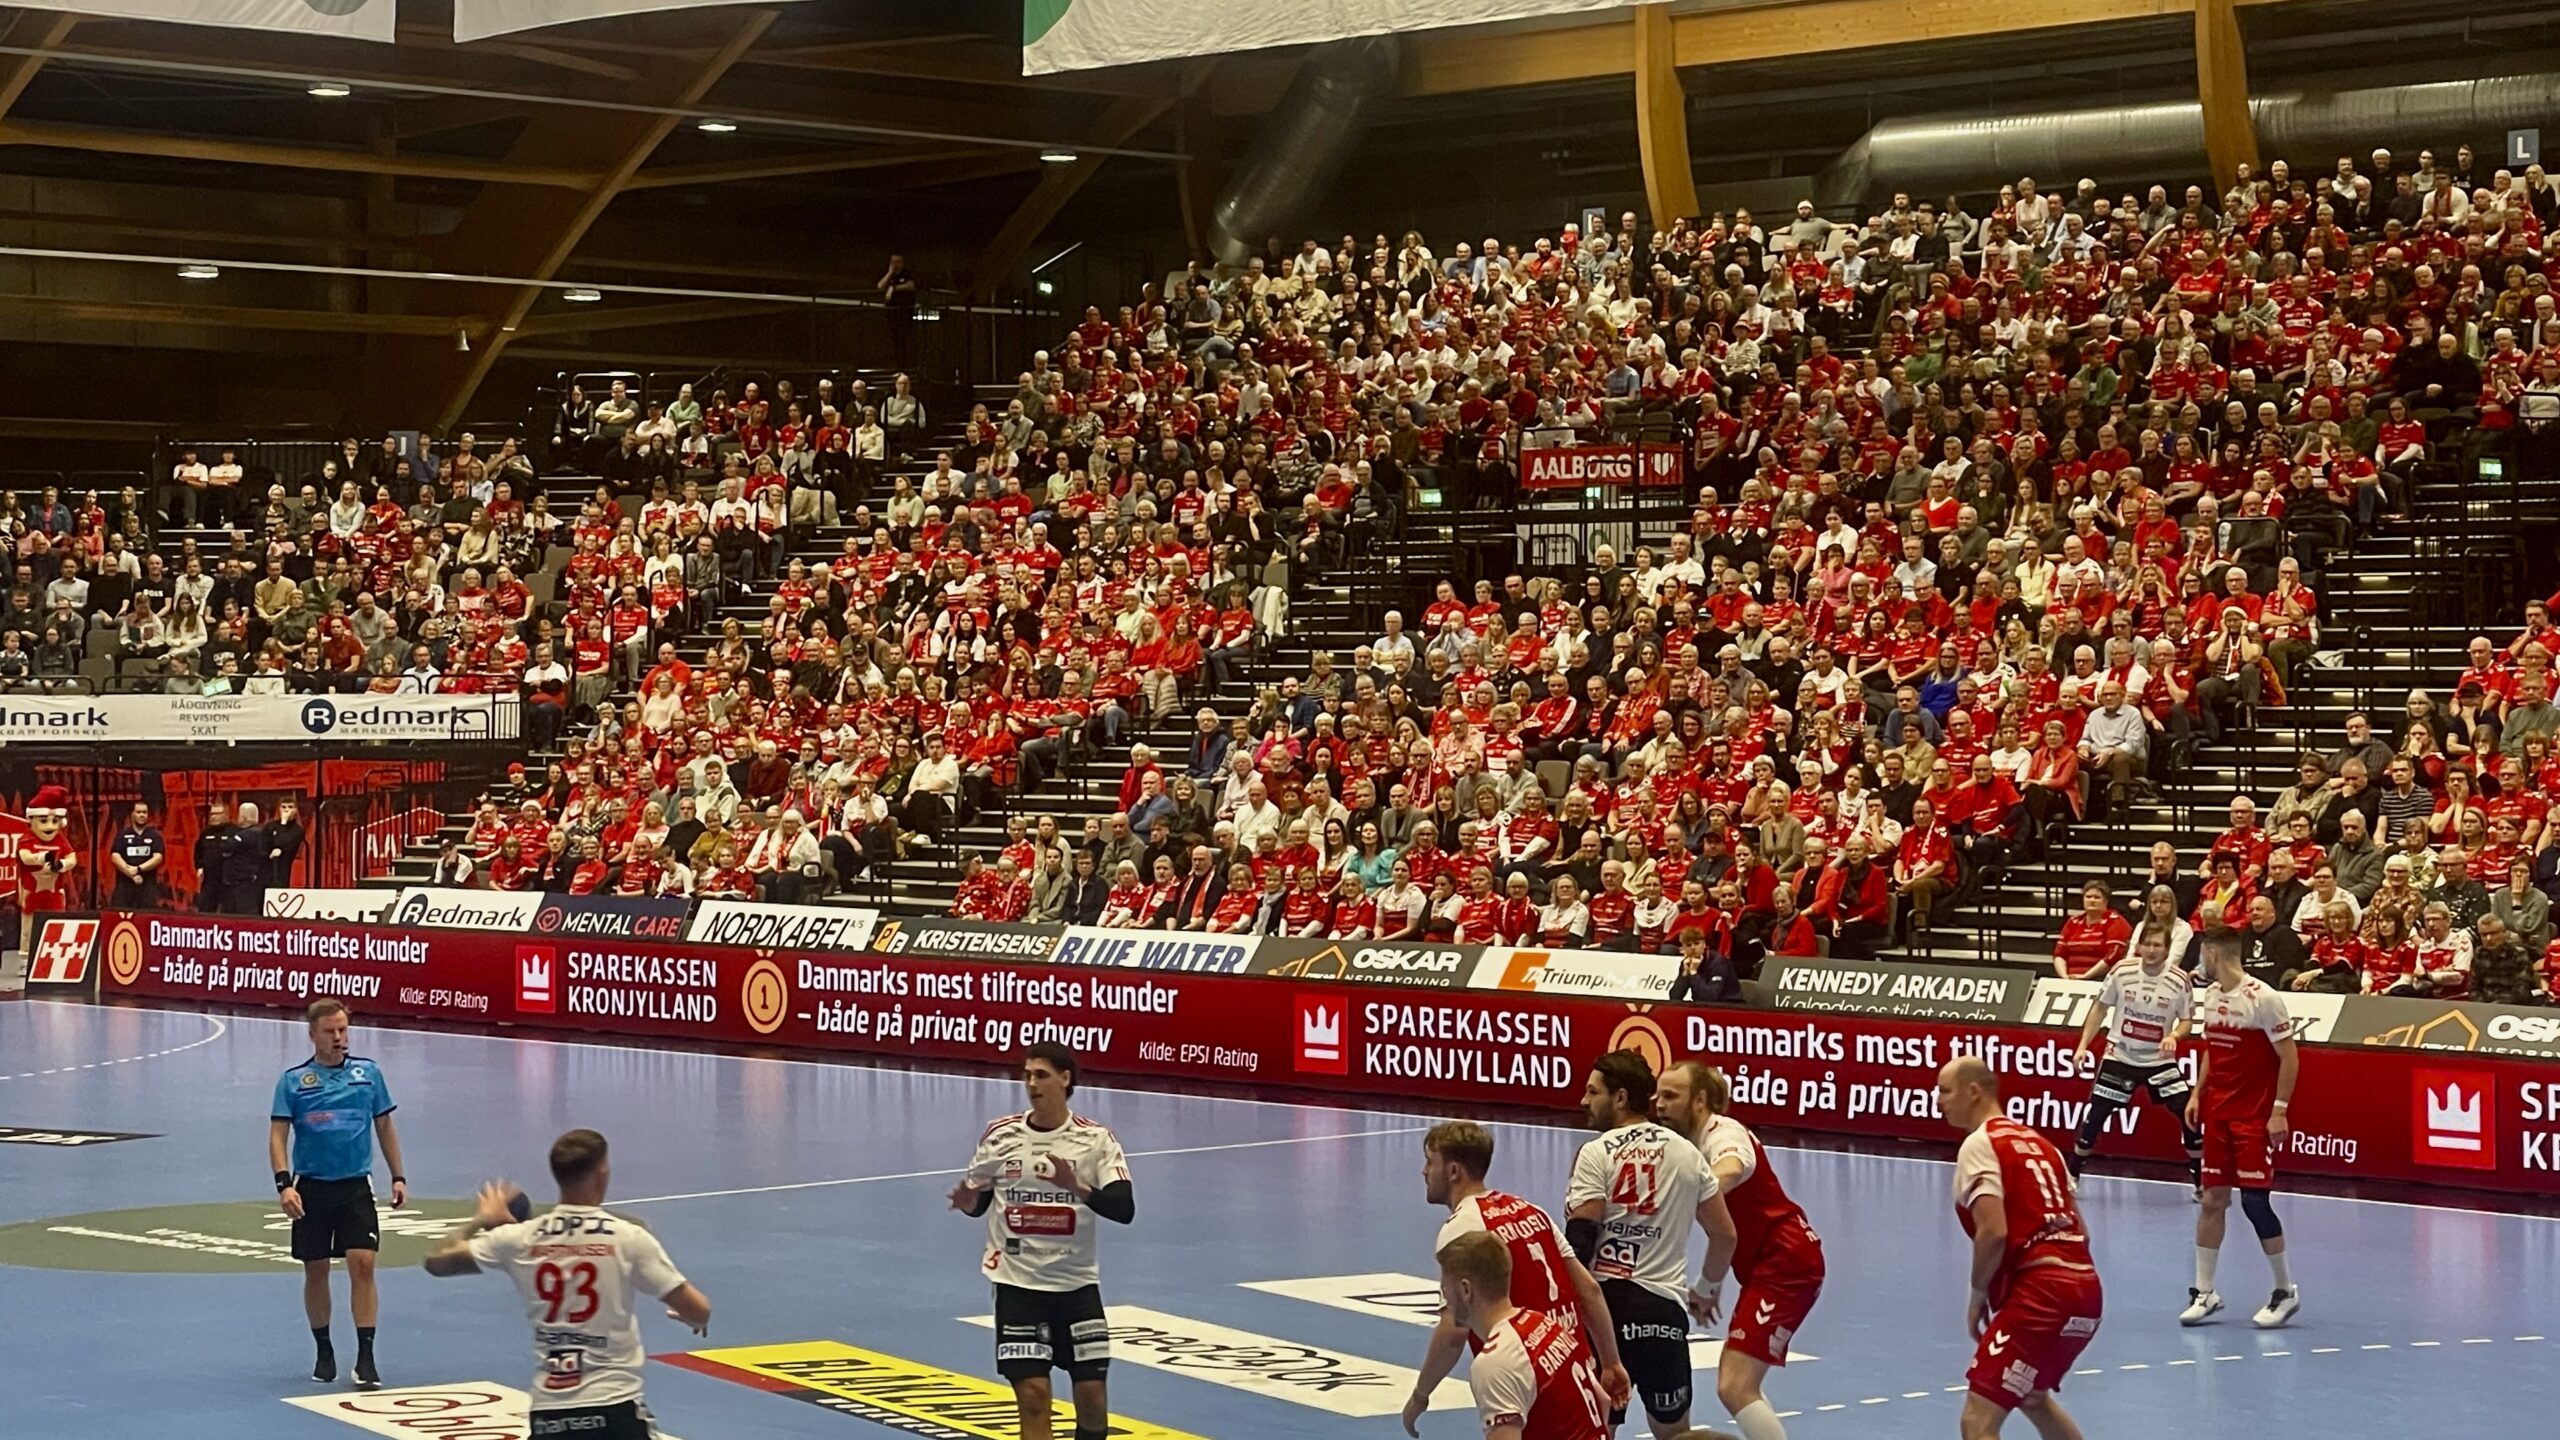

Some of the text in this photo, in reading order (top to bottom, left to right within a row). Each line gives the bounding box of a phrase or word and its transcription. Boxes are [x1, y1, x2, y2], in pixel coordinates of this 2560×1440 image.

[2517, 136, 2531, 159] L
[397, 436, 407, 457] J
[1530, 453, 1632, 481] AALBORG
[171, 699, 241, 710] RÅDGIVNING
[179, 713, 230, 722] REVISION
[303, 701, 471, 730] Redmark
[191, 726, 217, 736] SKAT
[401, 896, 525, 927] Redmark
[561, 911, 682, 937] MENTAL CARE
[150, 920, 429, 964] Danmarks mest tilfredse kunder
[701, 911, 854, 949] NORDKABEL
[913, 929, 1050, 956] KRISTENSENS
[40, 942, 89, 959] HTH
[1139, 941, 1247, 974] WATER
[1352, 948, 1462, 973] OSKAR
[164, 954, 203, 984] både
[208, 958, 228, 991] på
[233, 963, 283, 992] privat
[288, 970, 309, 998] og
[314, 968, 381, 998] erhverv
[568, 951, 717, 988] SPAREKASSEN
[1778, 967, 2008, 1004] KENNEDY ARKADEN
[400, 987, 489, 1013] Kilde: EPSI Rating
[798, 959, 1178, 1014] Danmarks mest tilfredse kunder
[568, 986, 717, 1023] KRONJYLLAND
[817, 999, 870, 1035] både
[876, 1003, 903, 1042] på
[910, 1010, 978, 1045] privat
[984, 1018, 1013, 1052] og
[1019, 1017, 1113, 1053] erhverv
[1364, 1002, 1571, 1048] SPAREKASSEN
[1686, 1015, 1844, 1061] Danmarks
[1855, 1034, 1937, 1068] mest
[1139, 1040, 1259, 1073] Kilde: EPSI Rating
[1365, 1042, 1572, 1089] KRONJYLLAND
[1798, 1070, 1837, 1116] på
[1848, 1079, 1943, 1119] privat
[2291, 1130, 2357, 1163] Rating
[1006, 1187, 1075, 1204] thansen
[1611, 1162, 1660, 1215] 41
[2025, 1159, 2064, 1209] 11
[1527, 1242, 1558, 1301] 7
[535, 1261, 599, 1323] 93
[1621, 1322, 1684, 1341] thansen
[1000, 1343, 1052, 1358] PHILIPS
